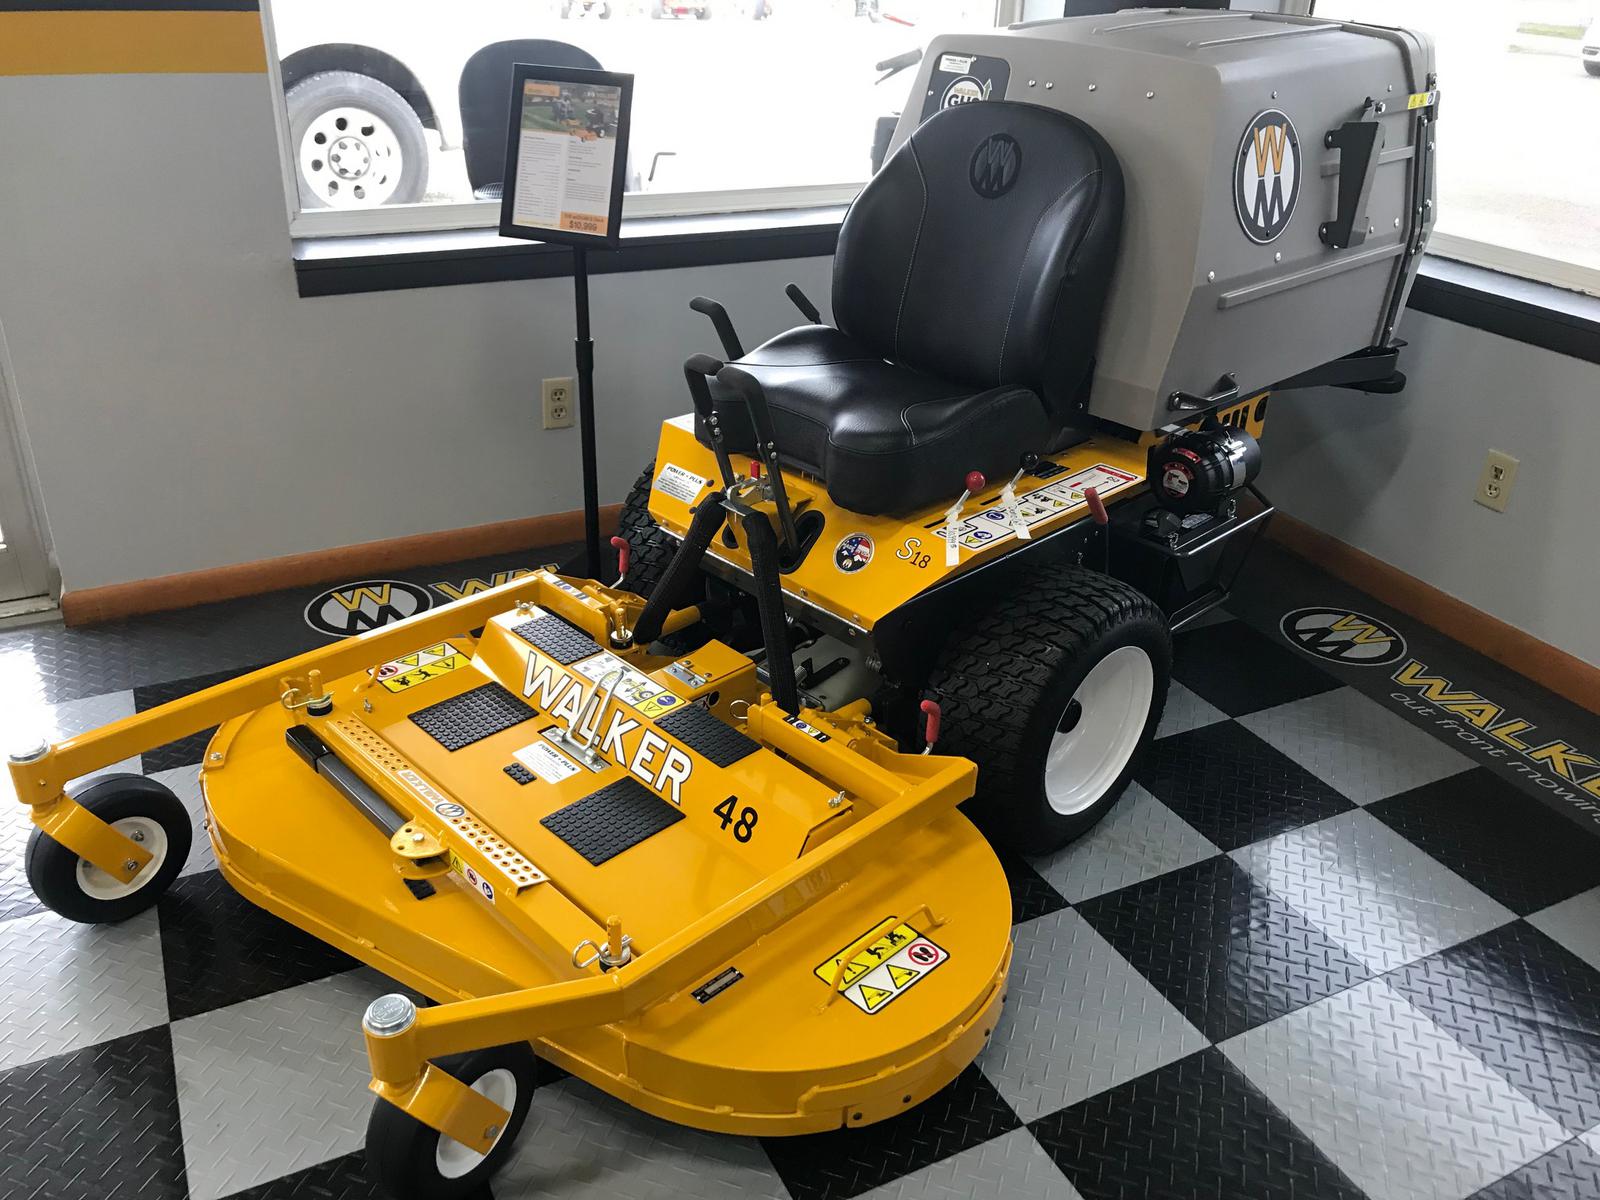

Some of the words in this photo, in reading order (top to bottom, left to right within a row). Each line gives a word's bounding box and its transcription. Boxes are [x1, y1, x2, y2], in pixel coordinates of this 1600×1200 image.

[522, 650, 693, 806] WALKER
[1389, 692, 1437, 717] out
[1435, 718, 1509, 758] front
[713, 794, 759, 844] 48
